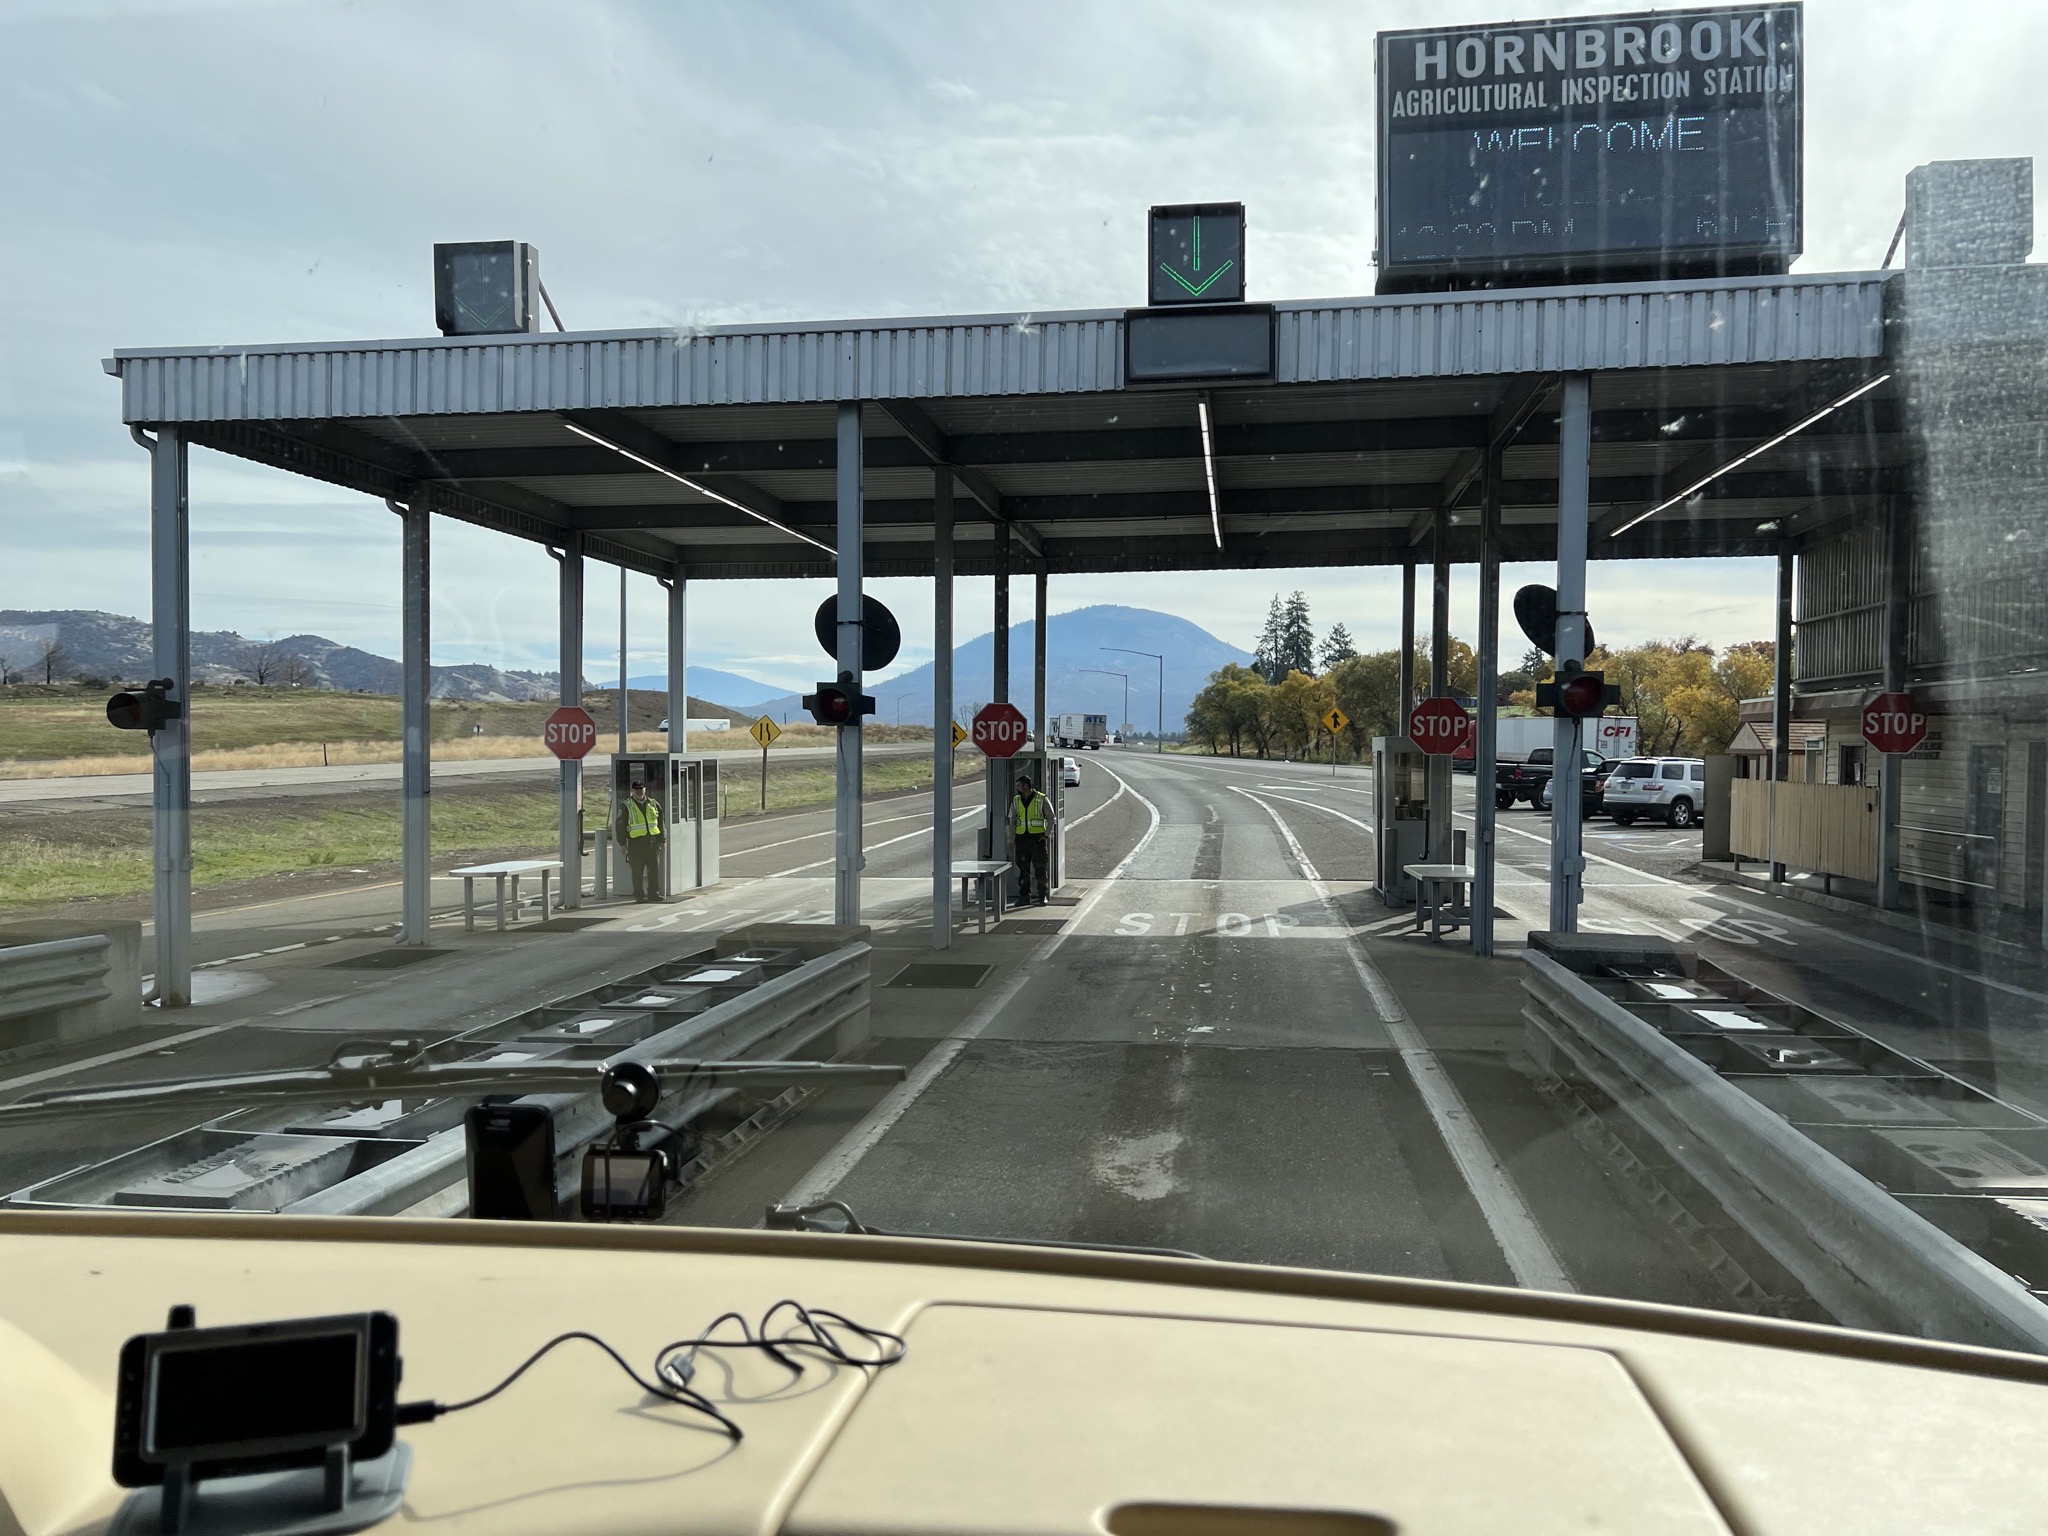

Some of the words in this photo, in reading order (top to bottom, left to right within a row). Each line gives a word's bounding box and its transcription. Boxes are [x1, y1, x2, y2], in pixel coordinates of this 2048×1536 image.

[1414, 17, 1767, 82] HORNBROOK
[1392, 81, 1548, 119] AGRICULTURAL
[1560, 70, 1691, 107] INSPECTION
[1703, 63, 1795, 97] STATION
[546, 722, 594, 744] STOP
[975, 719, 1026, 742] STOP
[1412, 714, 1468, 738] STOP
[1603, 725, 1632, 738] CFI
[1864, 711, 1926, 735] STOP
[1113, 912, 1301, 938] STOP
